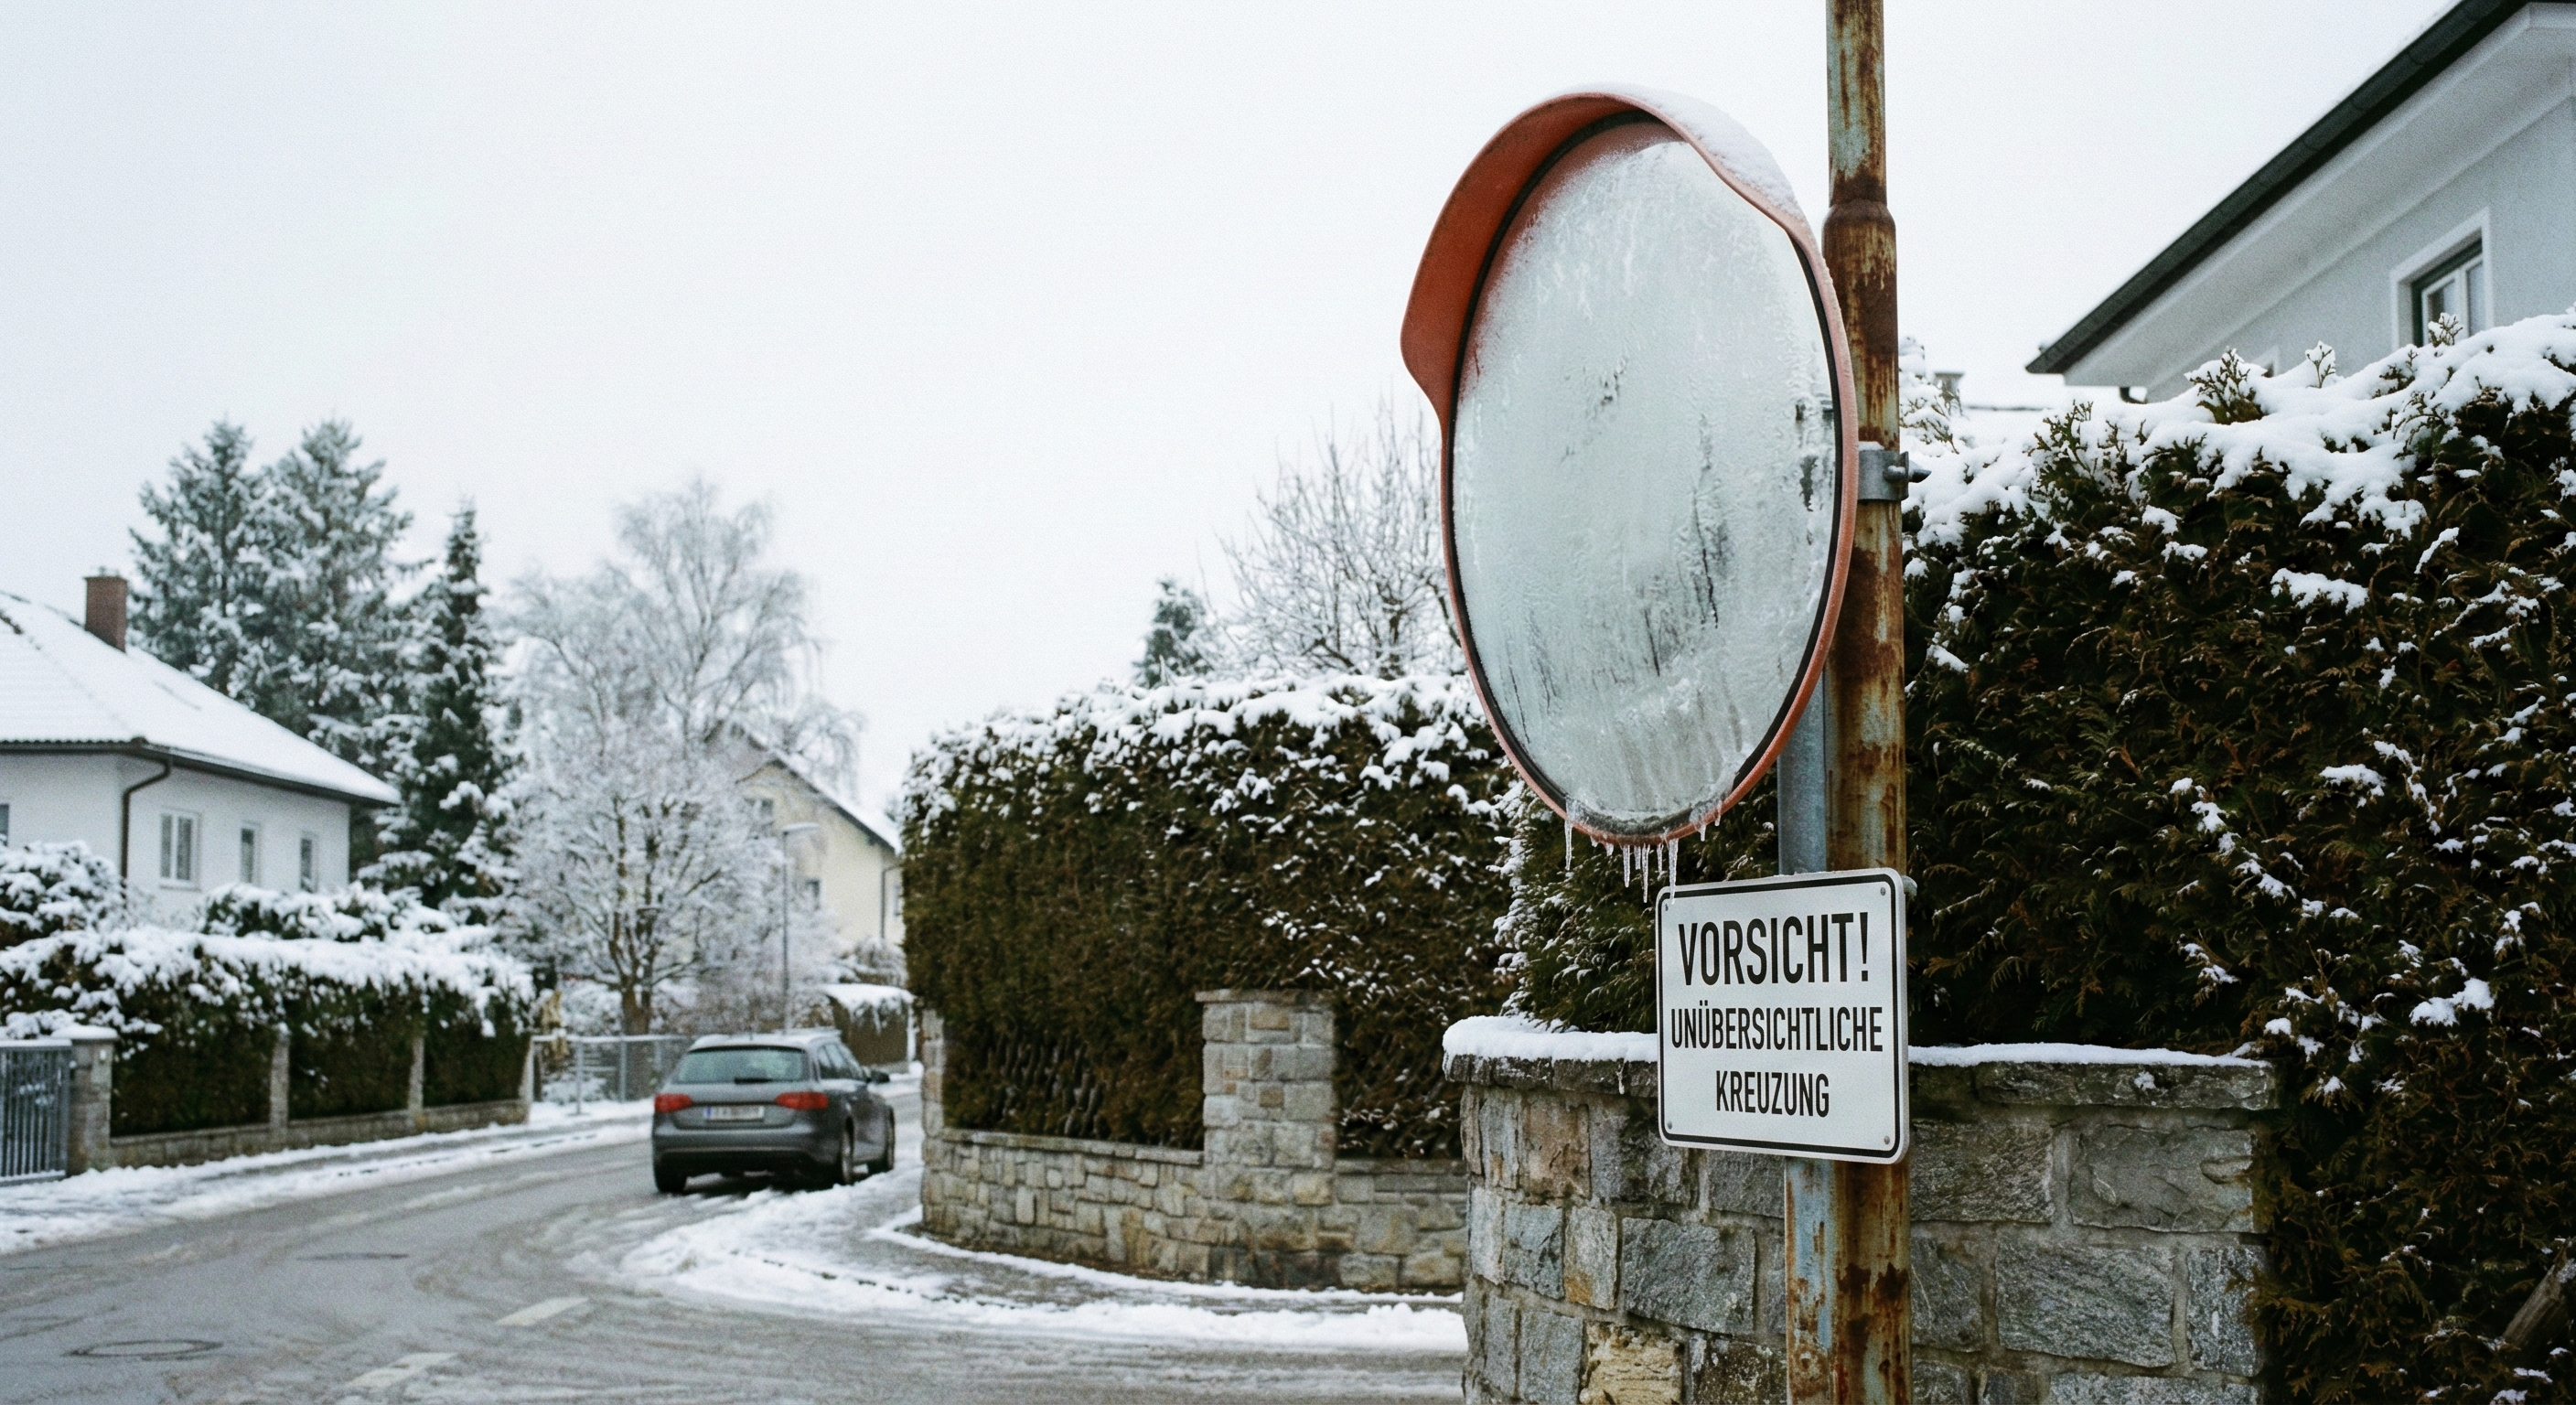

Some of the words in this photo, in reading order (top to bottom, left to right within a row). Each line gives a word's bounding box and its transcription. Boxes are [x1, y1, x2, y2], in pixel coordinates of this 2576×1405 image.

[1679, 912, 1869, 986] VORSICHT!
[1671, 1000, 1884, 1052] UNÜBERSICHTLICHE
[1716, 1070, 1830, 1118] KREUZUNG
